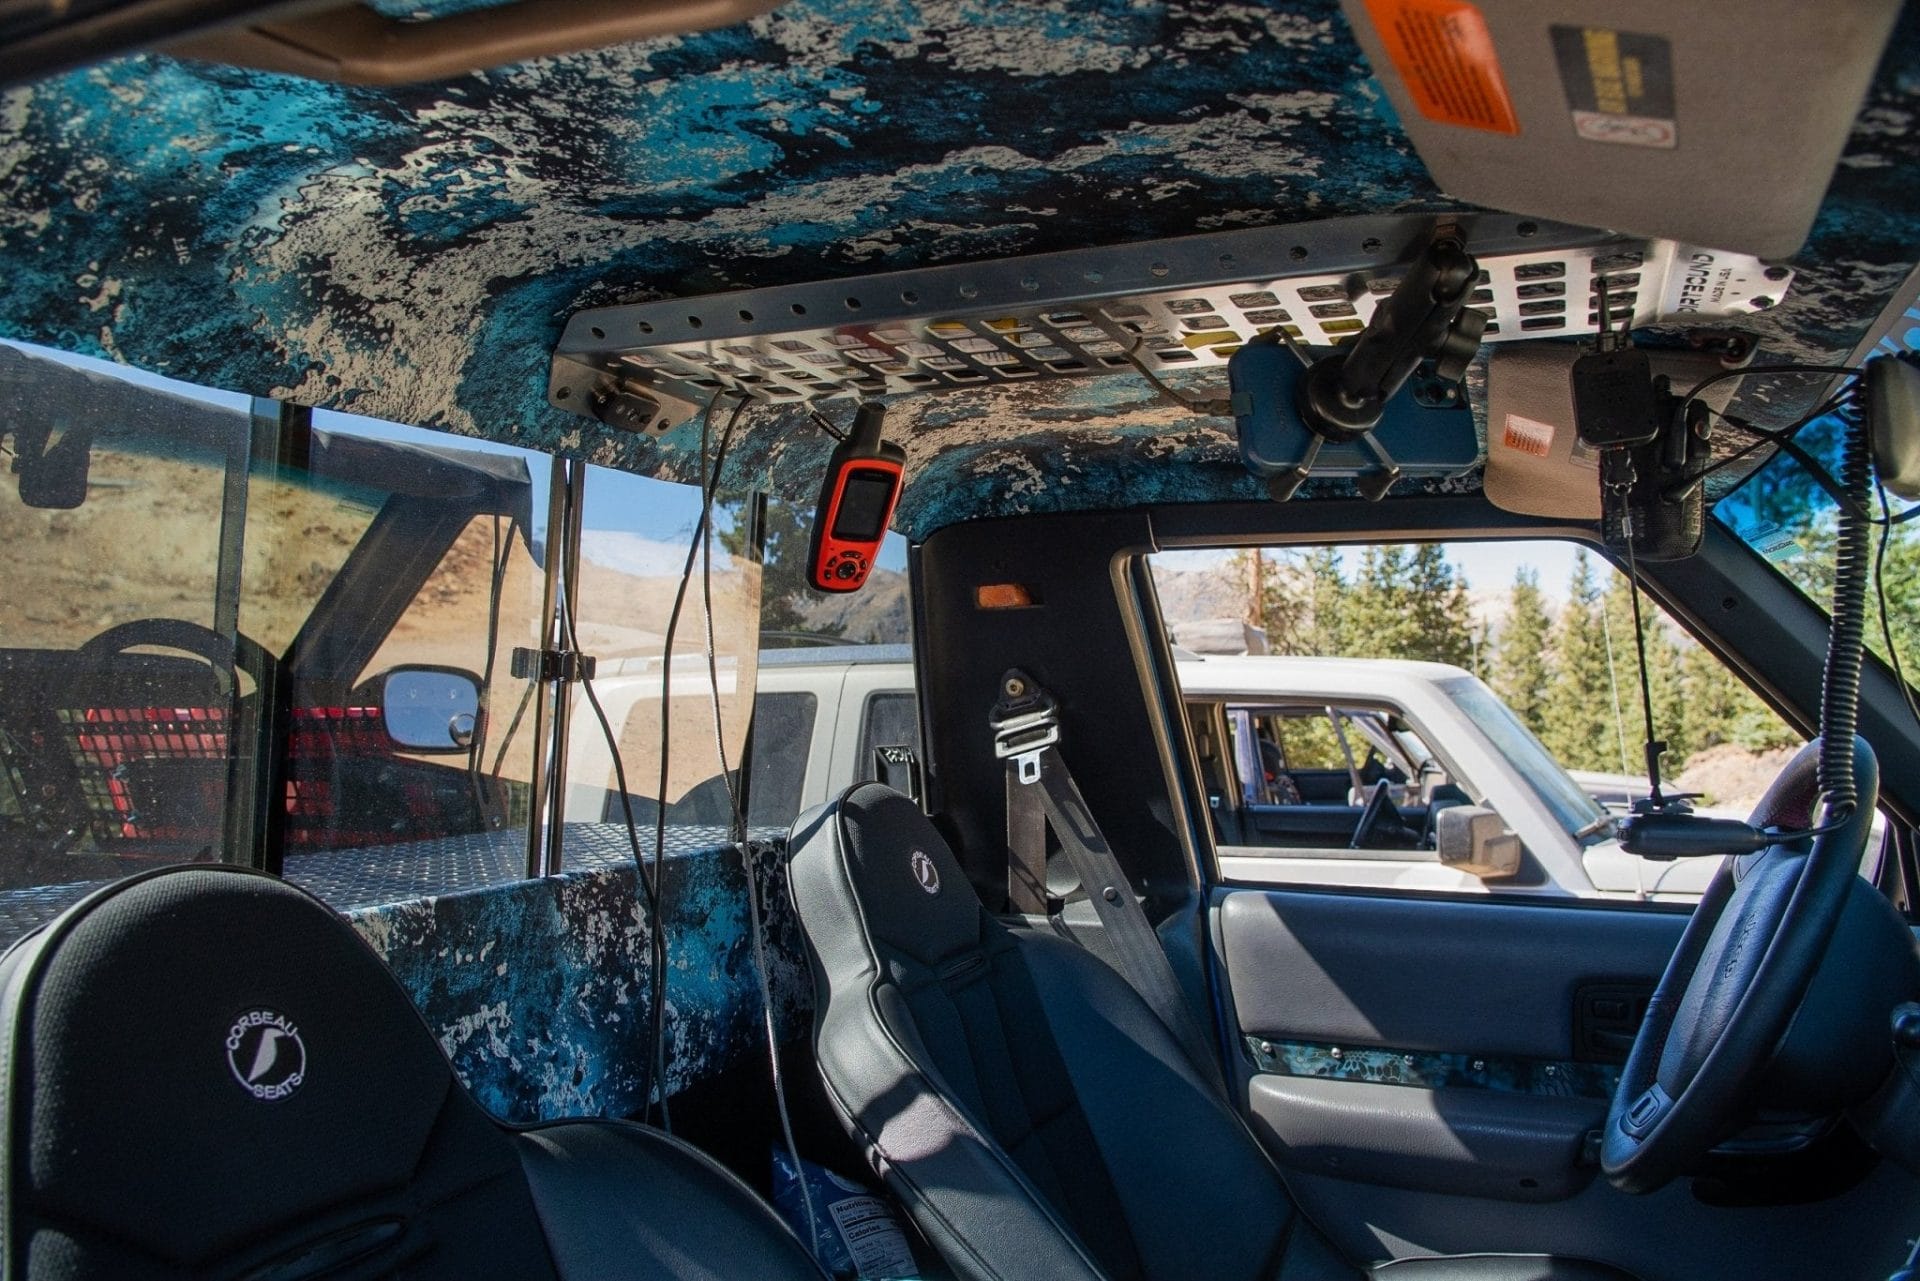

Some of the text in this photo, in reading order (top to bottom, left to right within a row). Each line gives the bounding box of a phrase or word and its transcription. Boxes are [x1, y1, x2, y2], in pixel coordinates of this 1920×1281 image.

[226, 1011, 298, 1050] CORBEAU
[253, 1072, 302, 1100] SEATS
[849, 1225, 880, 1240] Calories
